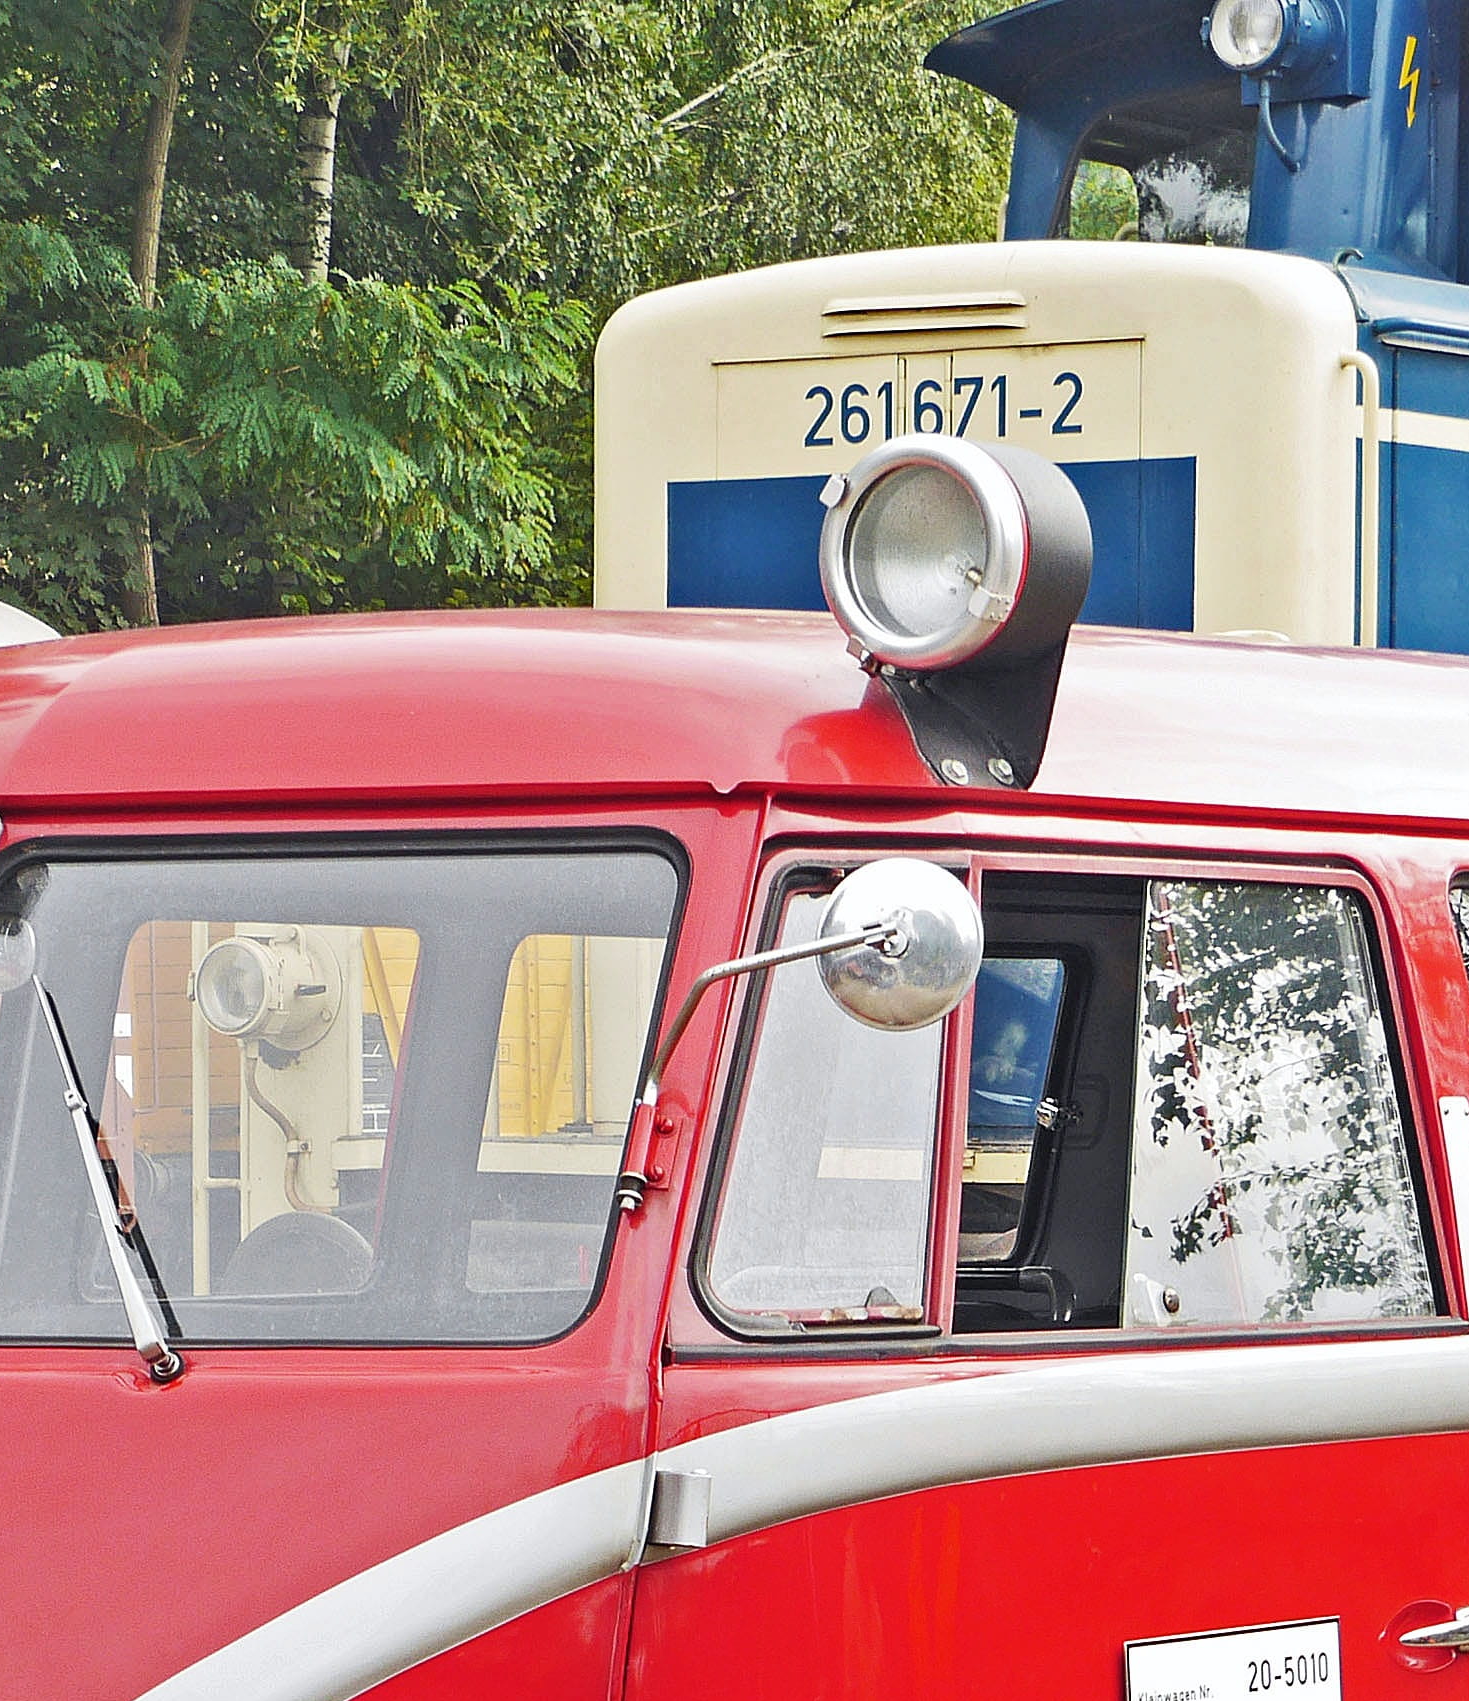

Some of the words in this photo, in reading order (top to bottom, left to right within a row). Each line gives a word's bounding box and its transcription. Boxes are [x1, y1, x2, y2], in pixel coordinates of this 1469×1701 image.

[805, 381, 893, 447] 261
[914, 372, 1083, 438] 671-2
[1248, 1652, 1328, 1692] 20-5010
